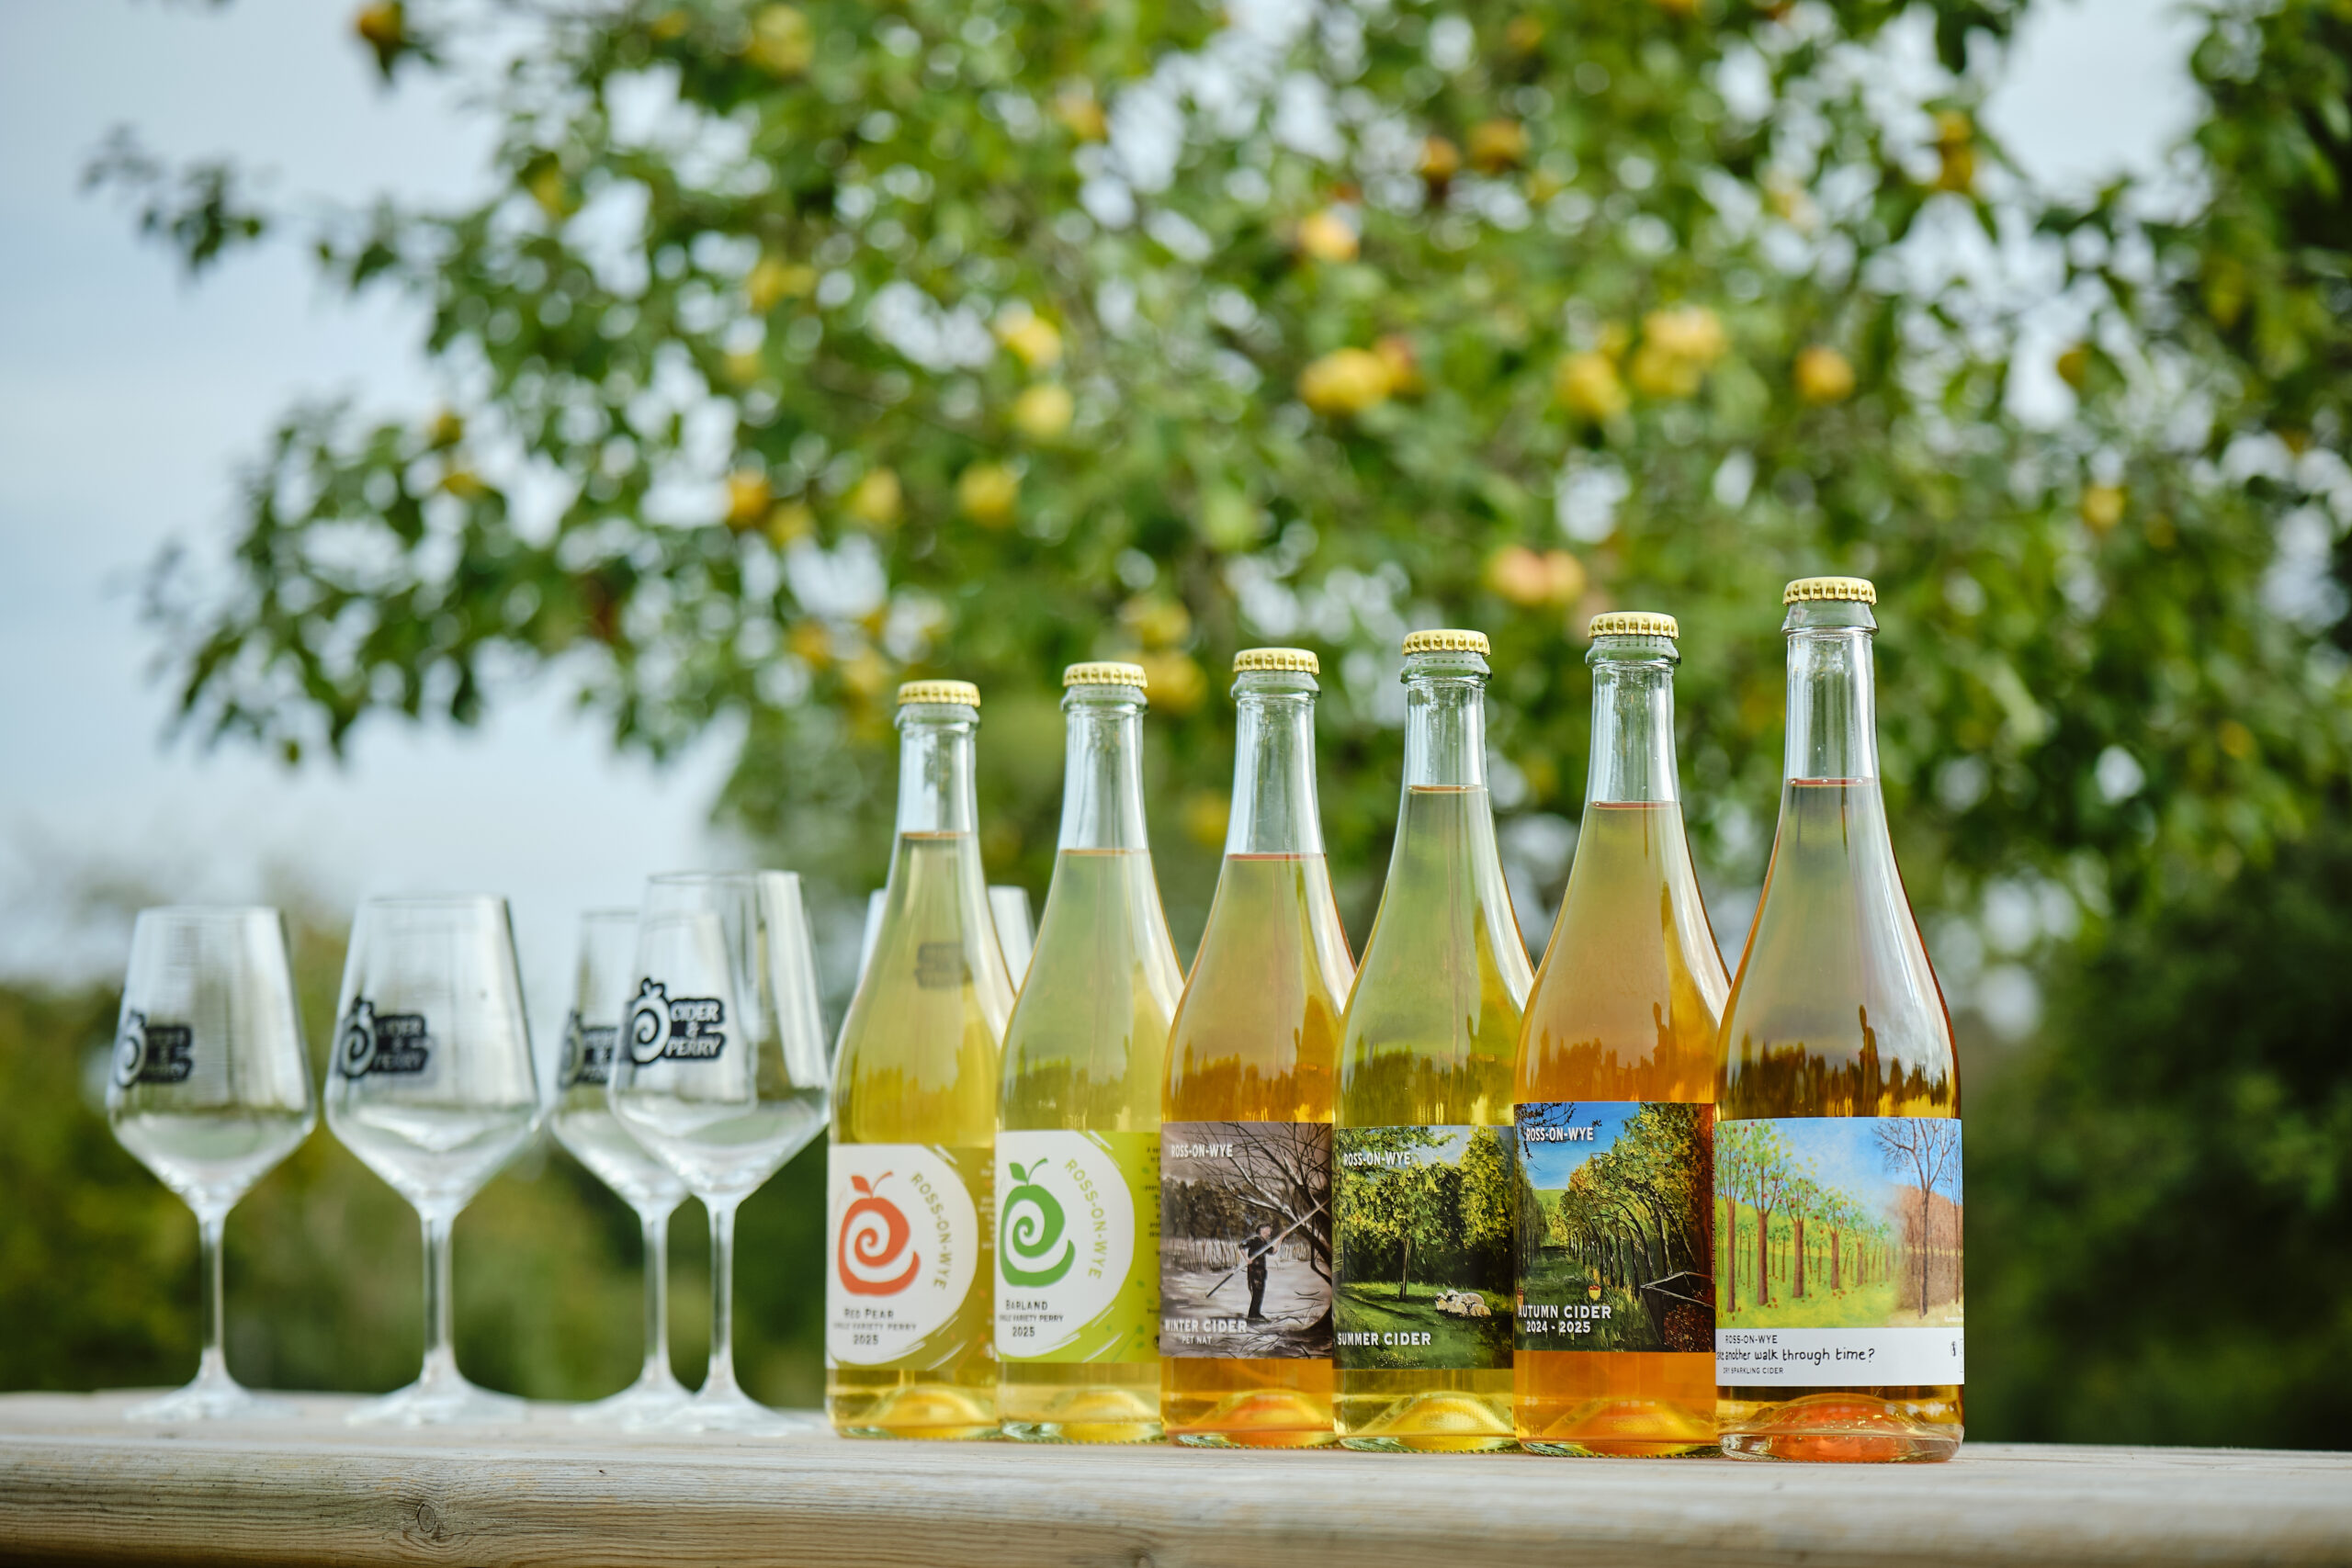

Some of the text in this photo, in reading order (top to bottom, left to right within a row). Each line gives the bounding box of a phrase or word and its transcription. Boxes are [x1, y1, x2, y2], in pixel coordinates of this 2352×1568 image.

[671, 1000, 719, 1021] CIDER
[685, 1021, 699, 1039] &
[665, 1037, 721, 1057] PERRY
[1525, 1126, 1594, 1142] ROSS-ON-WYE
[1170, 1144, 1233, 1157] ROSS-ON-WYE
[1343, 1151, 1411, 1167] ROSS-ON-WYE
[1064, 1158, 1108, 1280] ROSS-ON-WYE
[910, 1172, 952, 1290] ROSS-ON-WYE
[865, 1308, 894, 1320] PEAR
[1517, 1304, 1611, 1319] AUTUMN CIDER
[1012, 1325, 1035, 1337] 2025
[1164, 1319, 1248, 1333] WINTER CIDER
[1526, 1321, 1548, 1333] 2024
[1559, 1321, 1591, 1334] 2025
[854, 1334, 879, 1346] 2025
[1182, 1336, 1213, 1345] PET NAT
[1337, 1332, 1431, 1346] SUMMER CIDER
[1725, 1335, 1778, 1344] ROSS-ON-WYE
[1725, 1348, 1751, 1360] another
[1754, 1348, 1779, 1360] walk
[1782, 1348, 1830, 1366] through
[1836, 1347, 1875, 1363] time?
